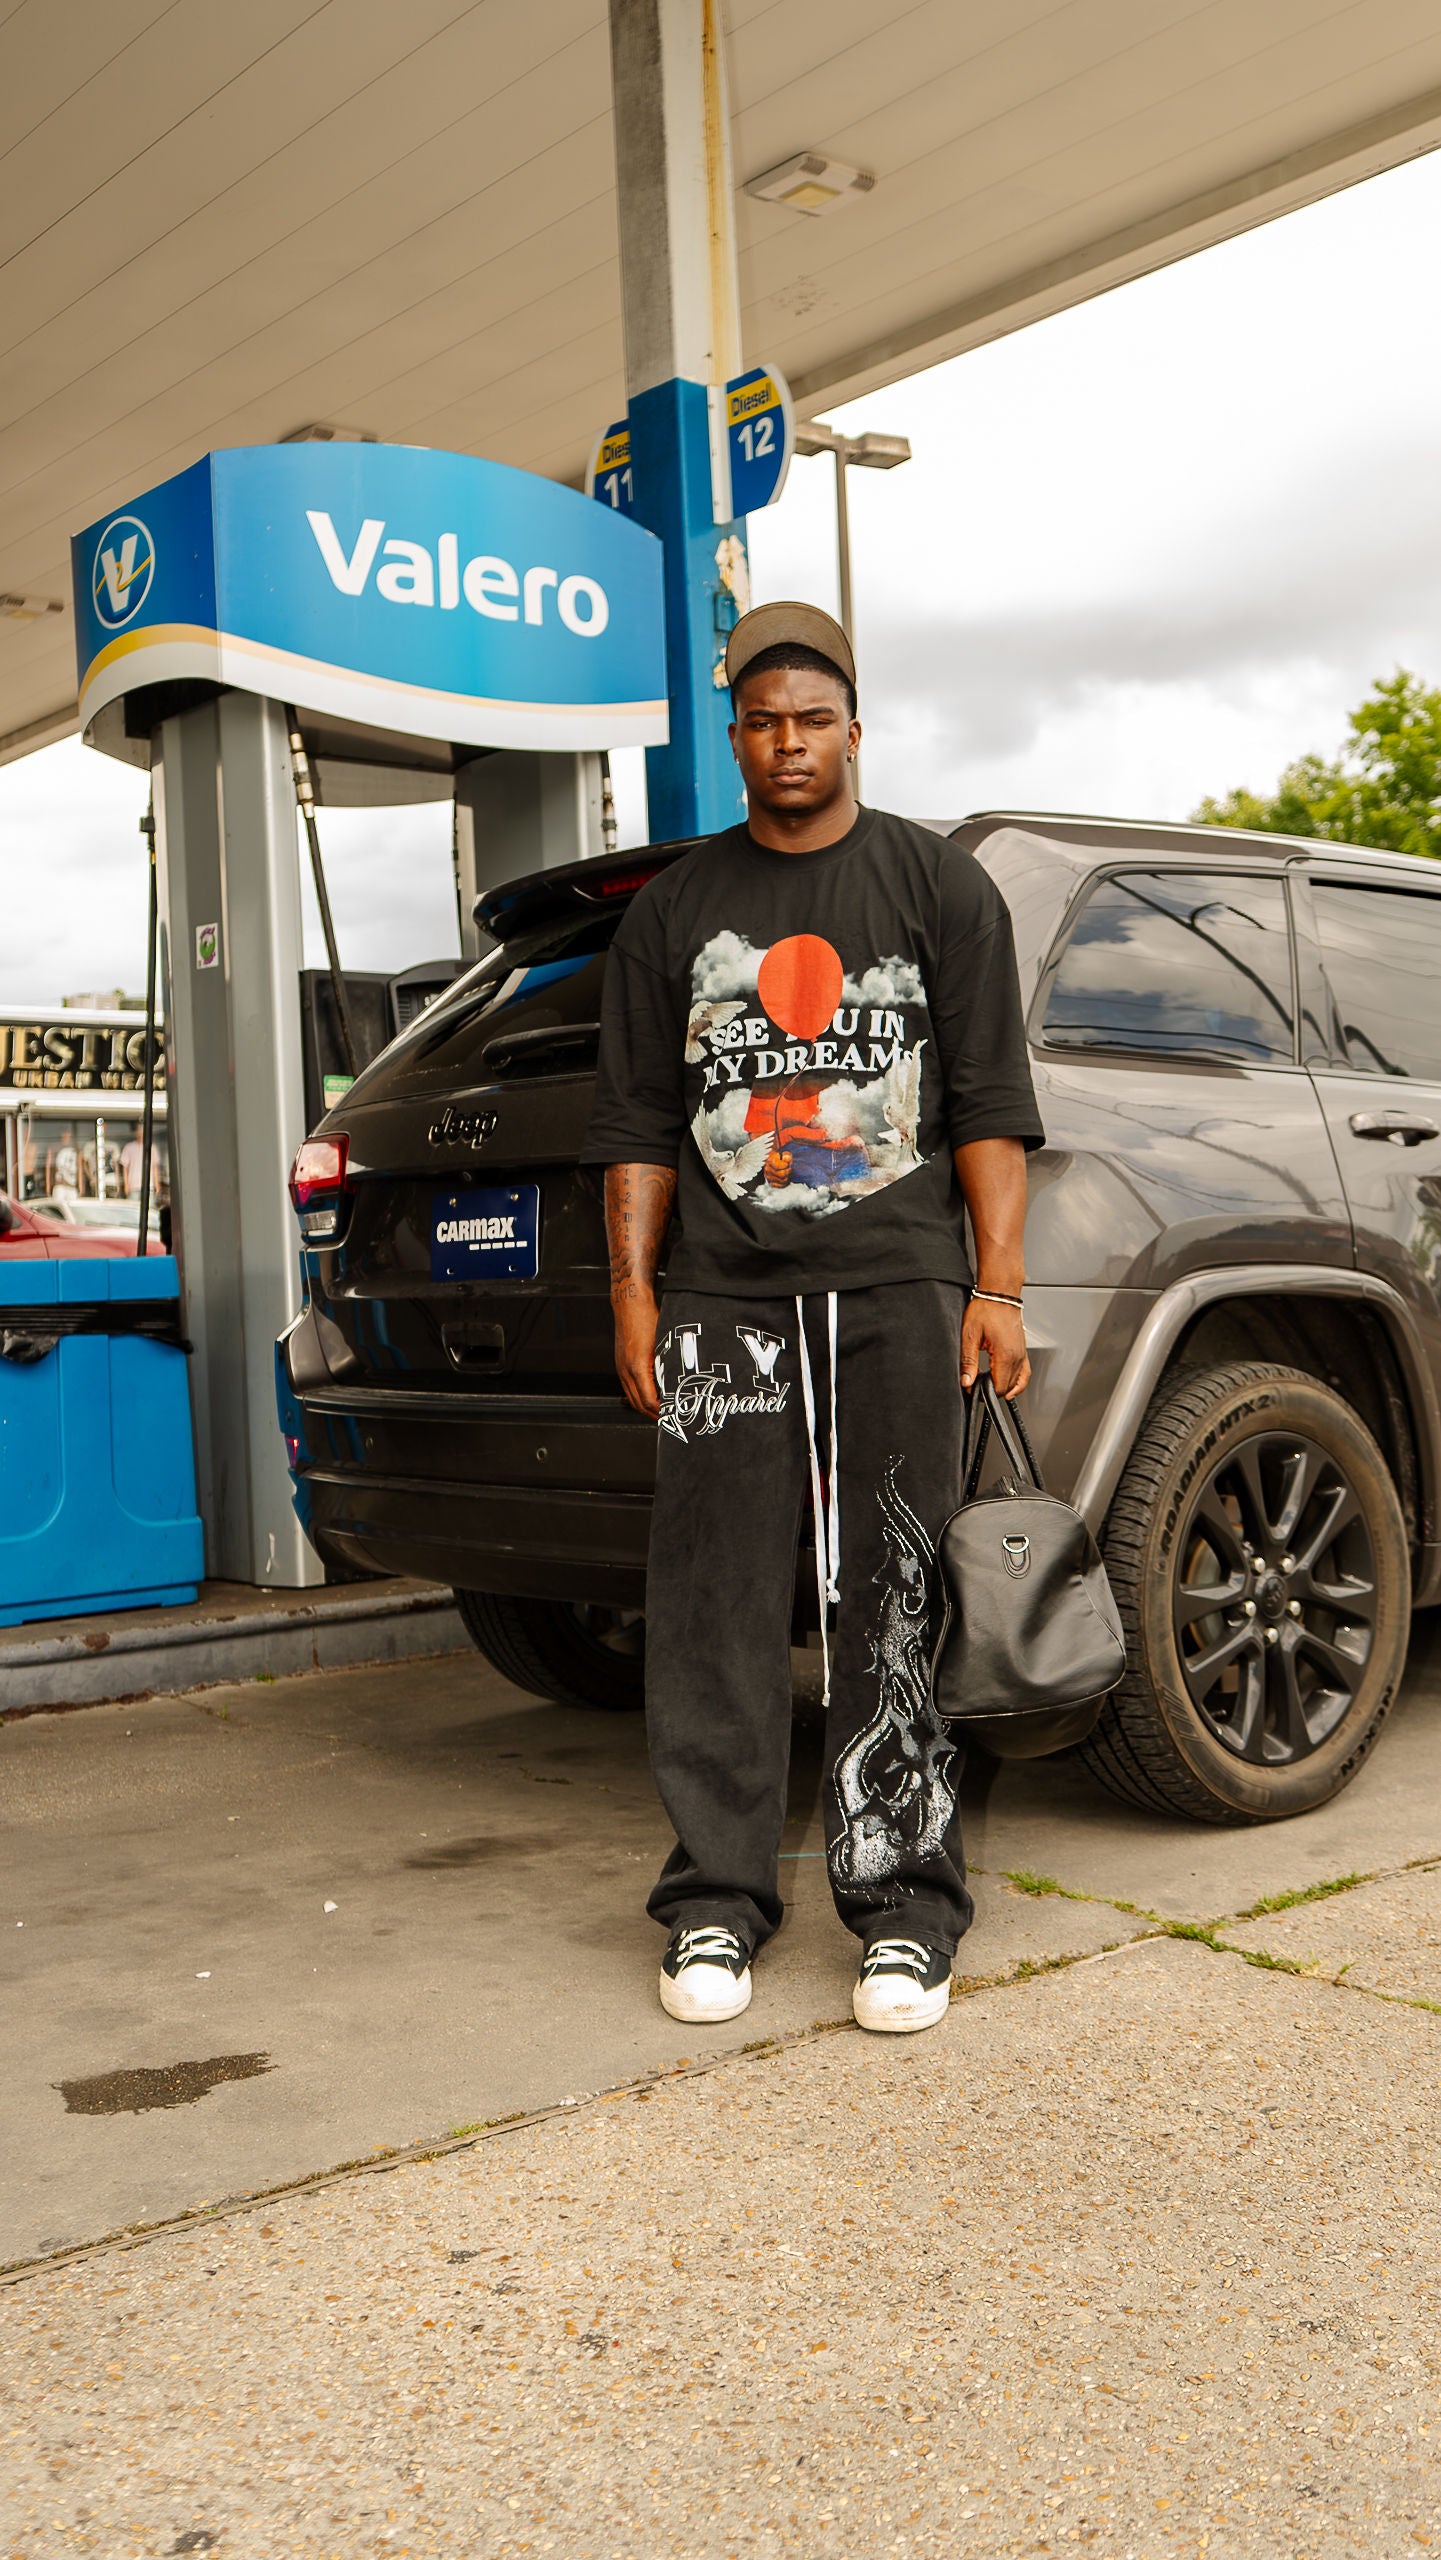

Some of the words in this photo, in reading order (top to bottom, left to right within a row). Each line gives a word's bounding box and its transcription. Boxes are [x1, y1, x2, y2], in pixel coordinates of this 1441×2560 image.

[732, 382, 772, 417] Diesel
[737, 416, 776, 462] 12
[604, 467, 633, 508] 11
[305, 510, 609, 637] Valero
[709, 1017, 770, 1055] SEE
[868, 1009, 904, 1041] IN
[13, 1070, 92, 1089] URBAN
[428, 1106, 498, 1149] Jeep
[675, 1372, 791, 1436] Apparel
[1160, 1429, 1217, 1554] ROADIAN
[1340, 1684, 1394, 1777] NEXEN
